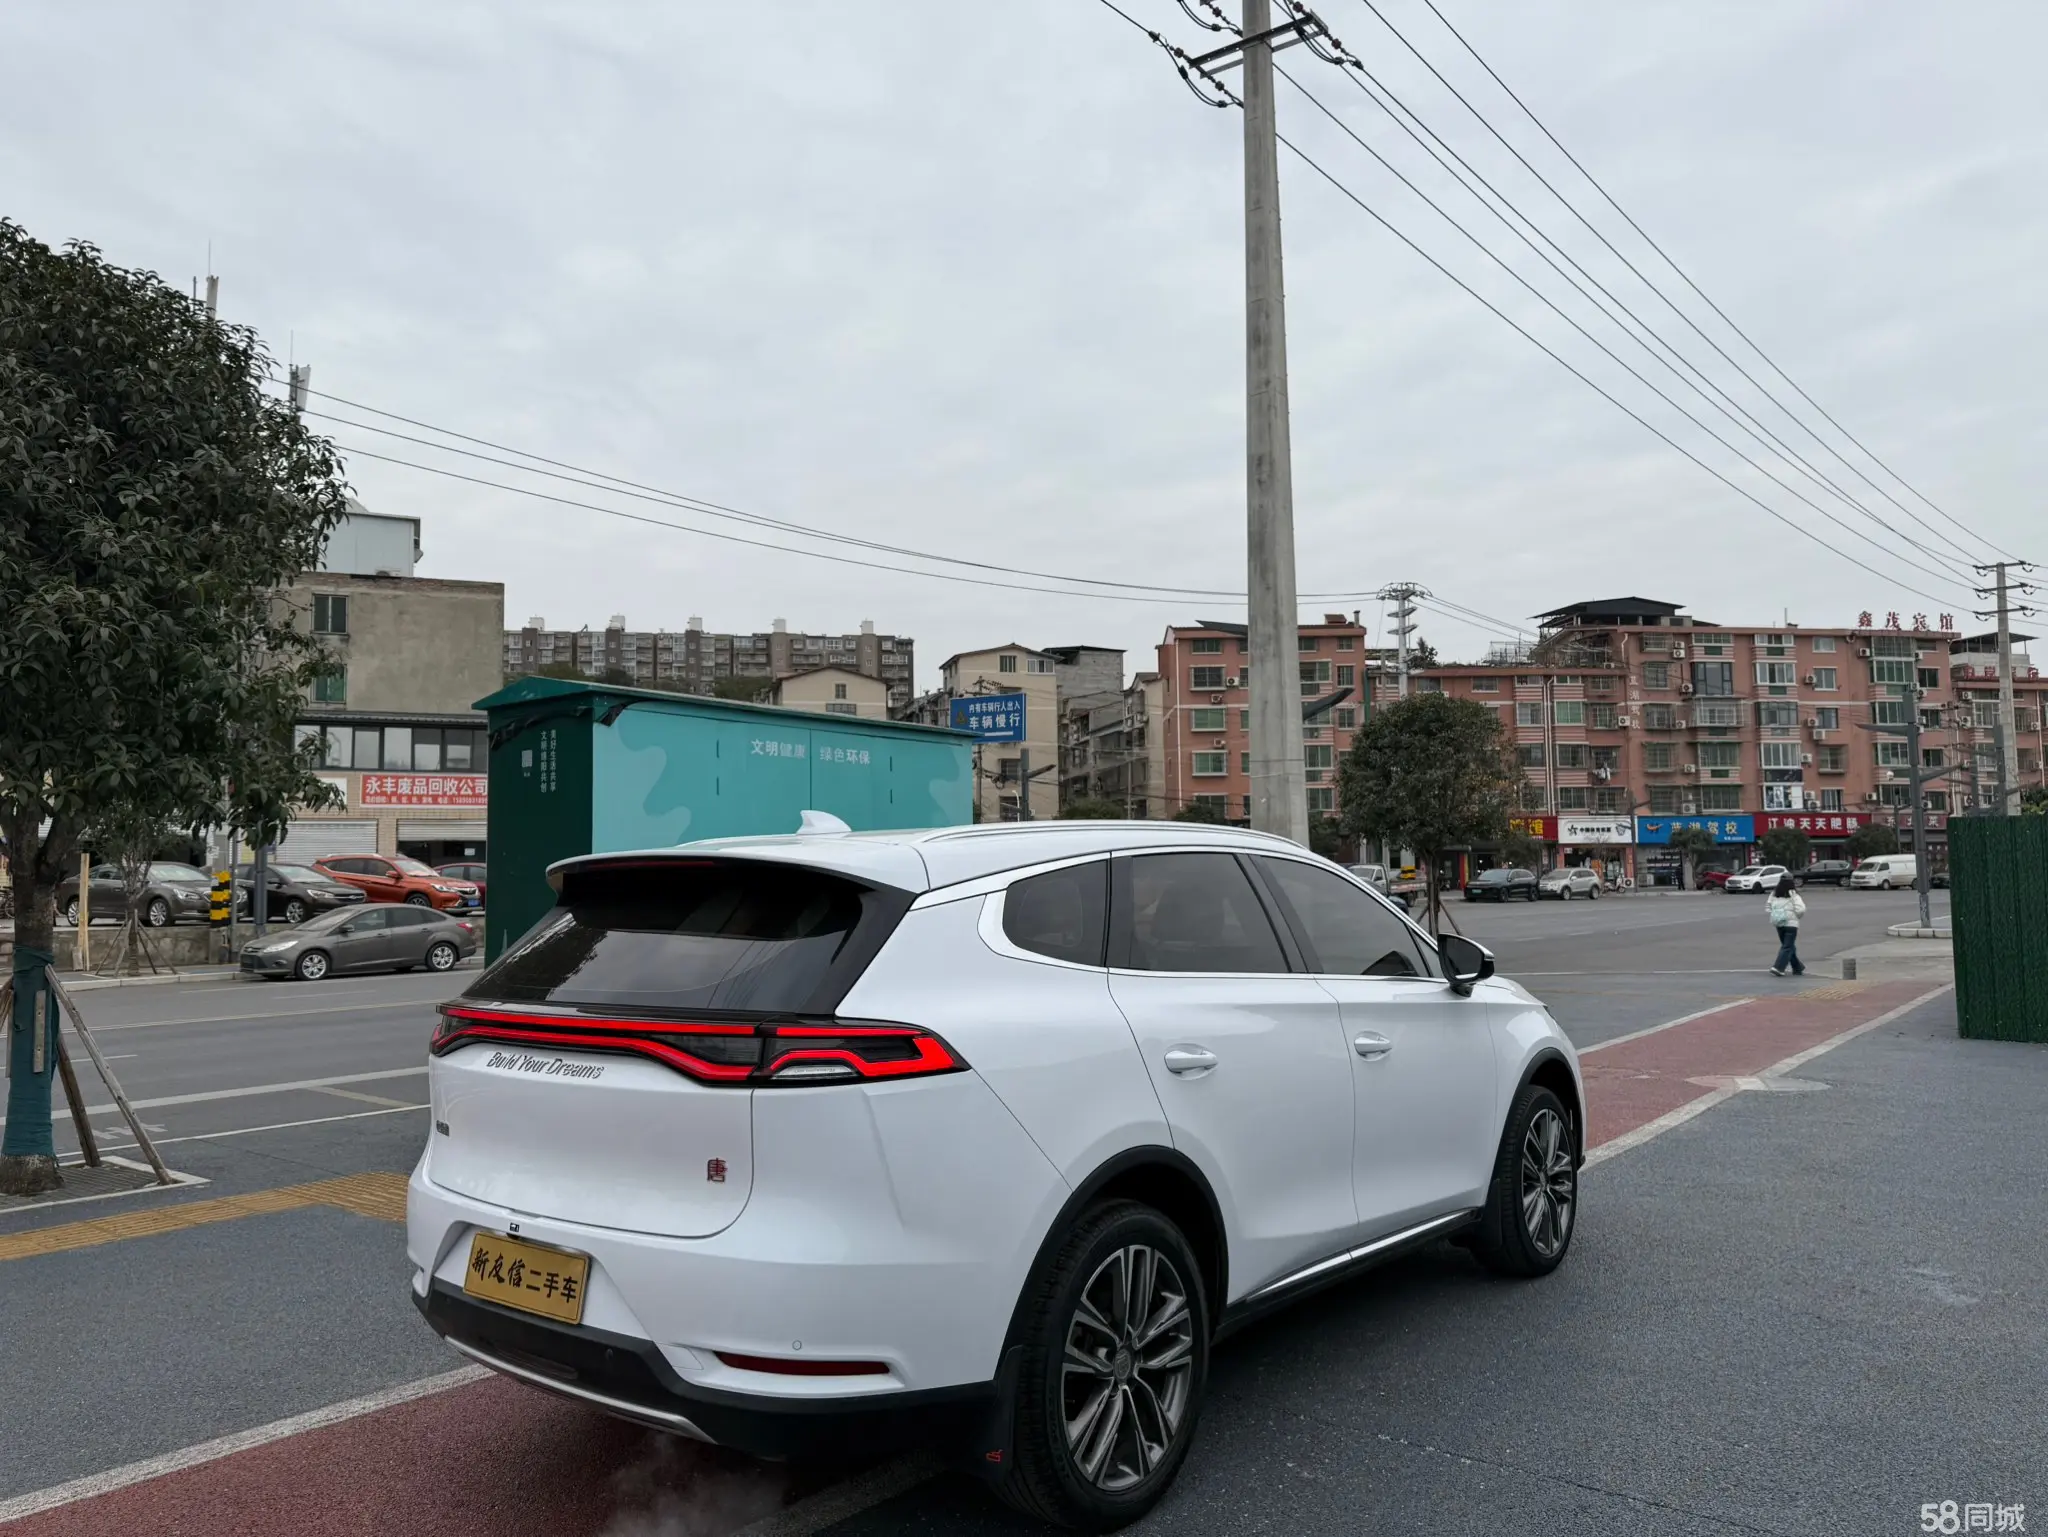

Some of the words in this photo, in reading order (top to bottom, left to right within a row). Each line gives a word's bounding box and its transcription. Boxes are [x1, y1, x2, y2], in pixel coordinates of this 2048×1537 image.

[1858, 611, 1955, 631] 鑫茂宾馆
[968, 701, 1021, 714] 内有车辆行人出入
[969, 713, 1021, 730] 车辆慢行
[750, 739, 806, 759] 文明健康
[819, 746, 871, 765] 绿色环保
[366, 777, 487, 795] 永丰废品回收公司
[486, 1051, 523, 1070] Build
[517, 1055, 550, 1074] Your
[545, 1058, 605, 1080] Dreams
[472, 1247, 578, 1303] 新友信二手车
